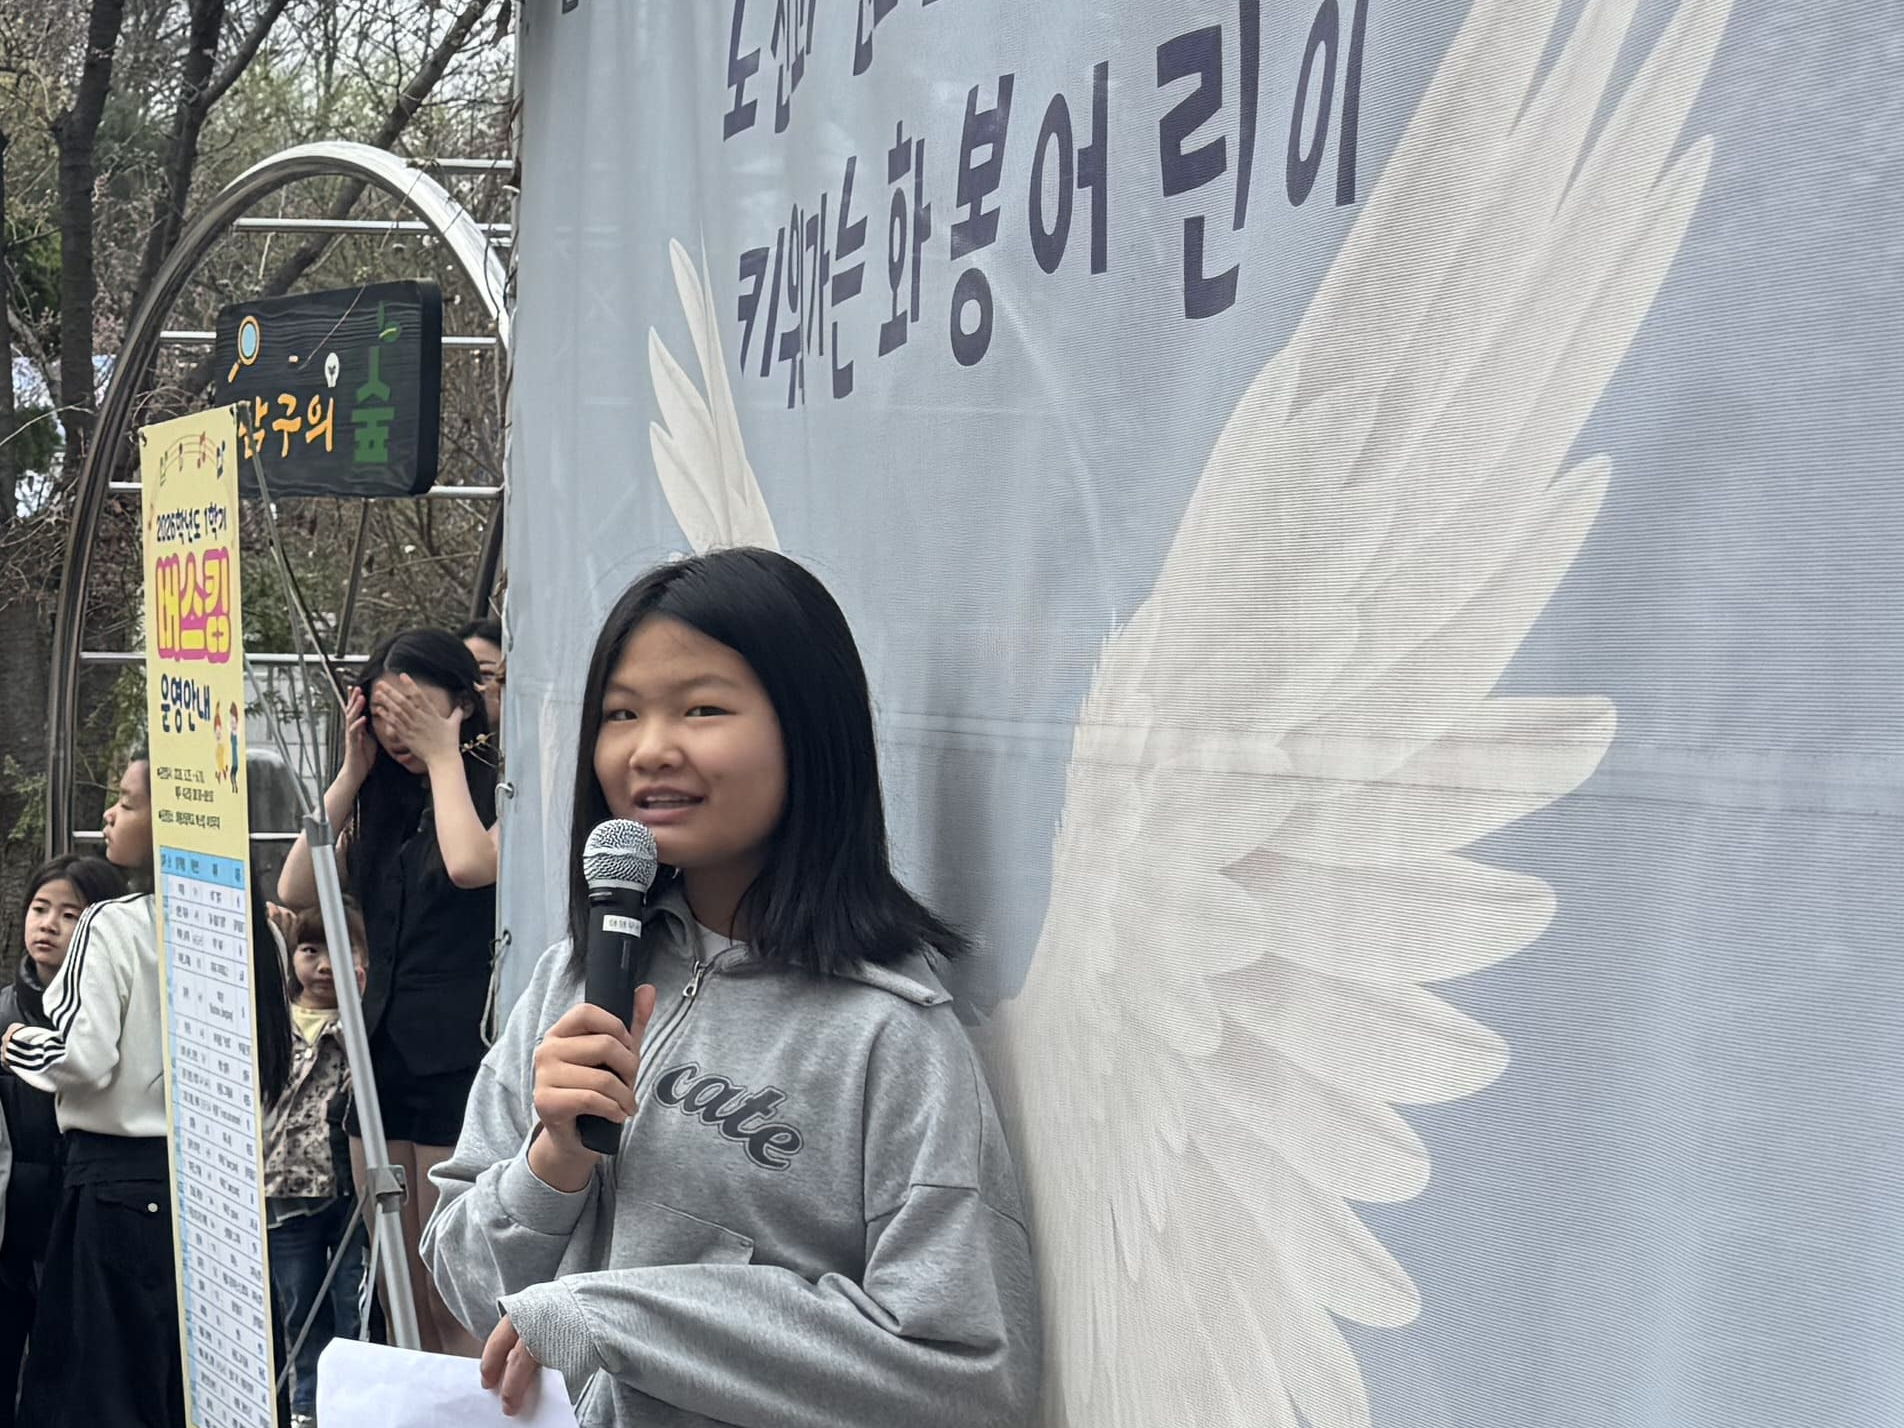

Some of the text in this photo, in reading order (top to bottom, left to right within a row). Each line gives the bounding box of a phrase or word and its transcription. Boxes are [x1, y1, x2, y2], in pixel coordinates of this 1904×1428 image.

[738, 155, 869, 410] 키워가는
[156, 502, 227, 546] 2026학년도 1학기
[155, 546, 231, 664] 버스킹
[653, 1061, 804, 1172] cate
